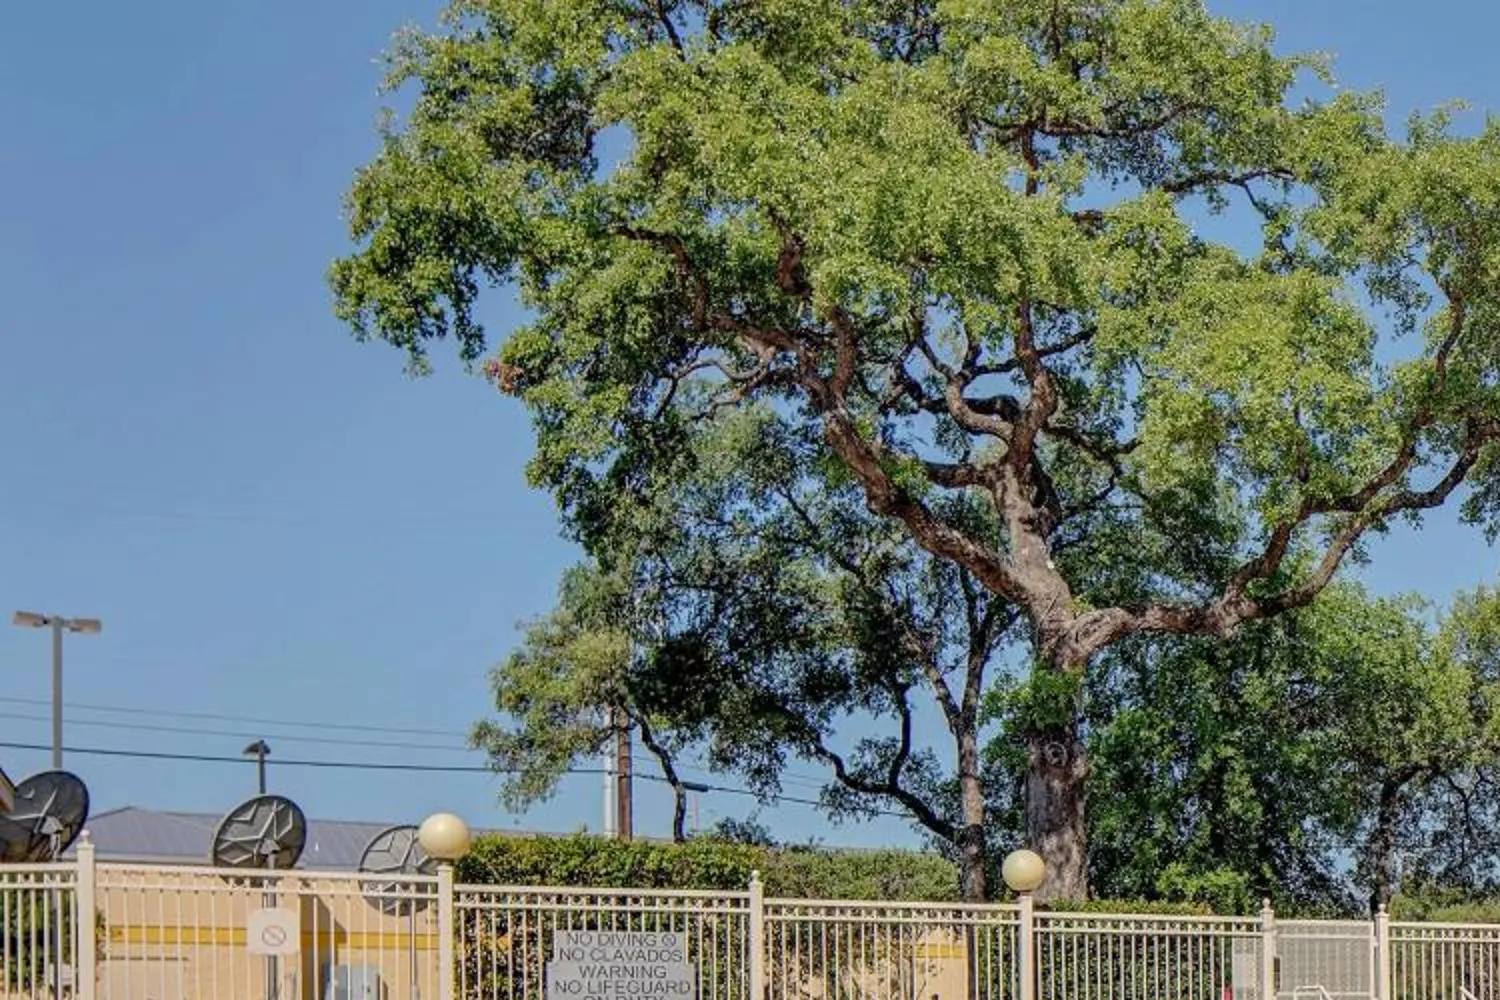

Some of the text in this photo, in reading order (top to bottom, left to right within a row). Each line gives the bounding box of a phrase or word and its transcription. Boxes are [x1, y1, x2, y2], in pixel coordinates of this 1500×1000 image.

[567, 933, 657, 947] NO DIVING
[559, 947, 683, 963] NO CLAVADOS
[578, 965, 667, 979] WARNING
[554, 980, 691, 995] NO LIFEGUARD
